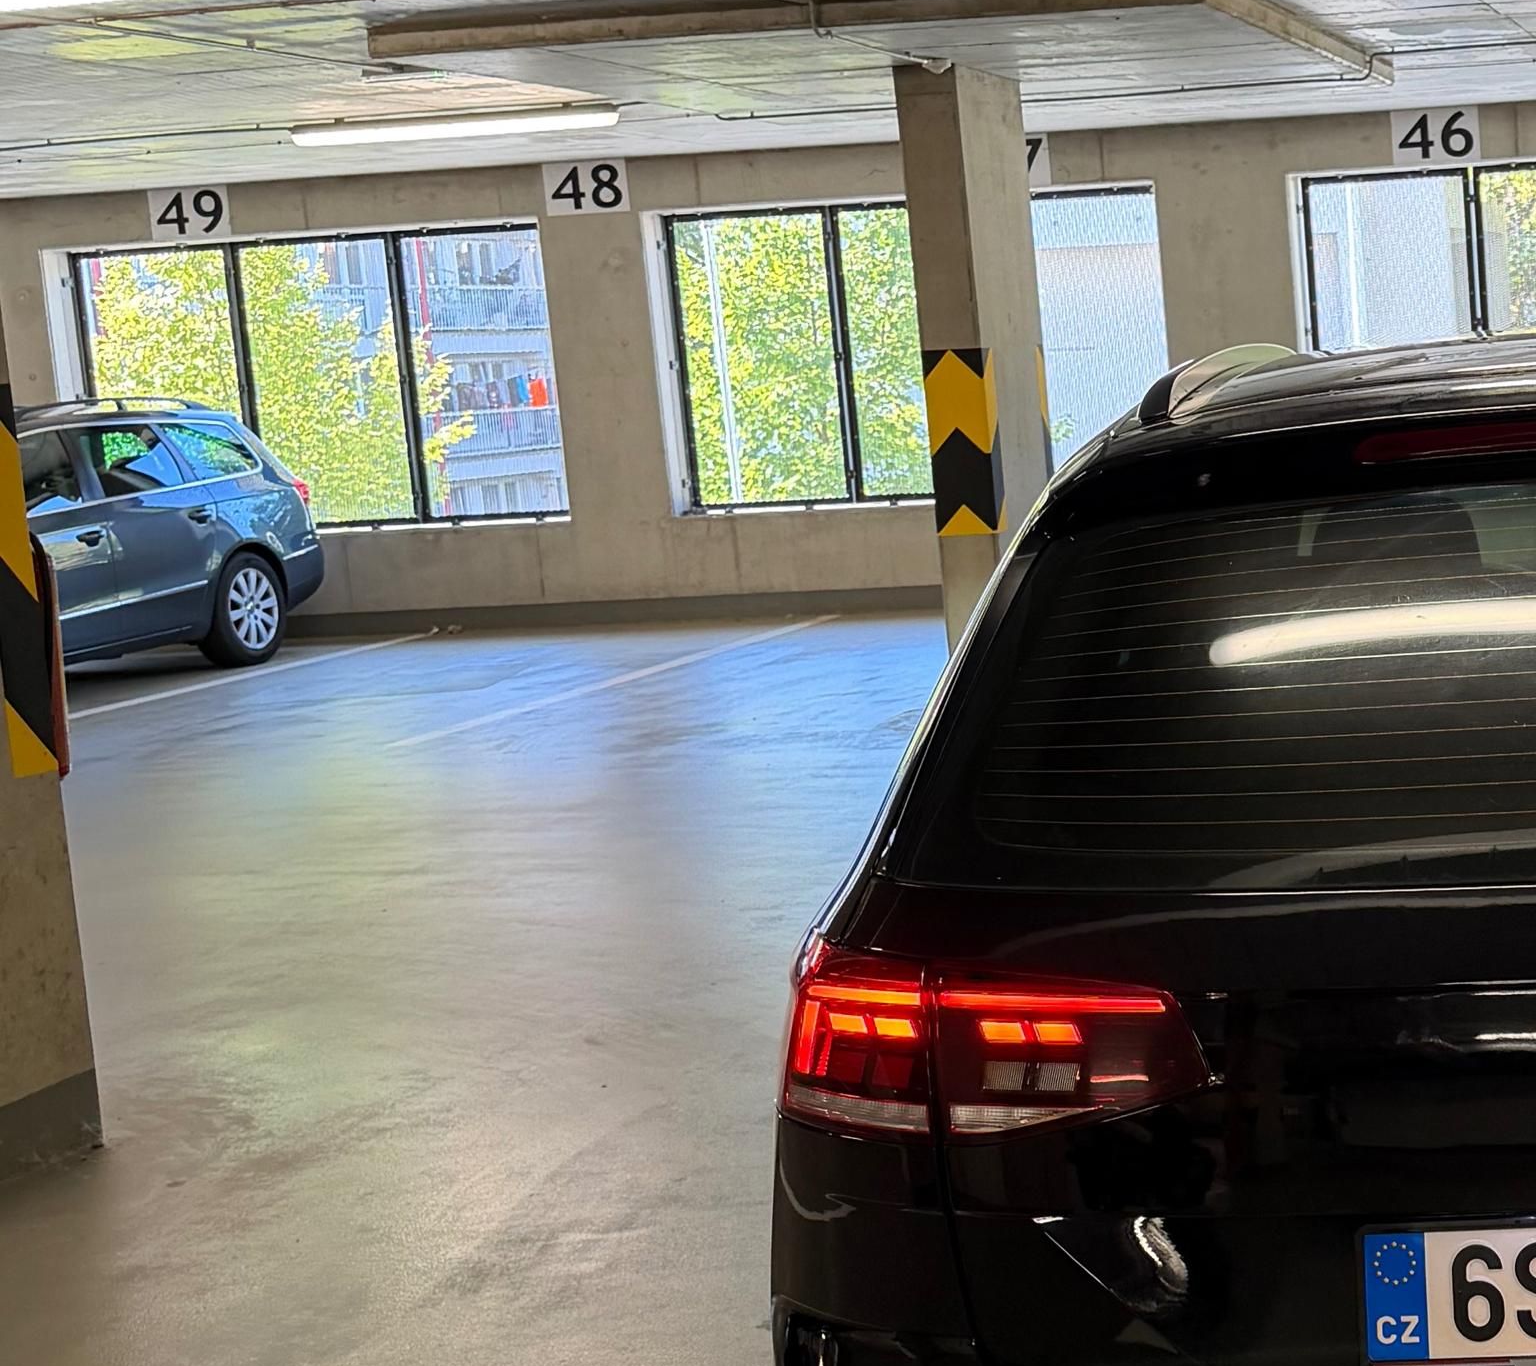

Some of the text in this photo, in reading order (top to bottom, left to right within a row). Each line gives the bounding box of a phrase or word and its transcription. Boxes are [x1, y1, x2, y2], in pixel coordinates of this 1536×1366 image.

[1025, 138, 1043, 173] 7
[1397, 109, 1475, 160] 46
[550, 163, 624, 210] 48
[156, 189, 224, 235] 49
[1376, 1315, 1420, 1345] CZ
